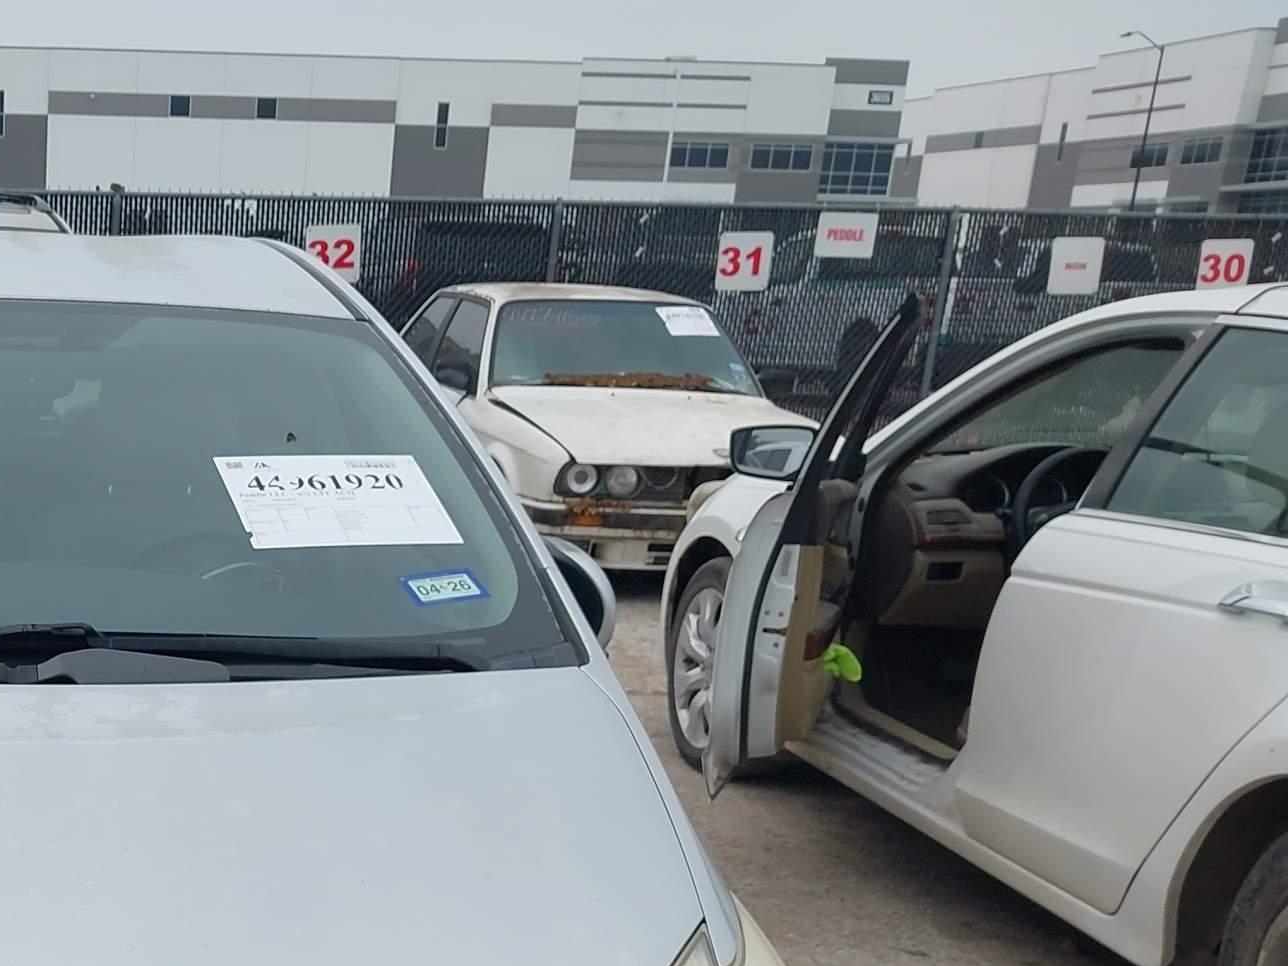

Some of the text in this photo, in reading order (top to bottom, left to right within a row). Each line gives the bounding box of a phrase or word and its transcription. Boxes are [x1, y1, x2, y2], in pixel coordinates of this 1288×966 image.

[826, 228, 865, 242] PEDDLE
[308, 239, 355, 269] 32
[719, 246, 763, 277] 31
[1200, 253, 1246, 283] 30
